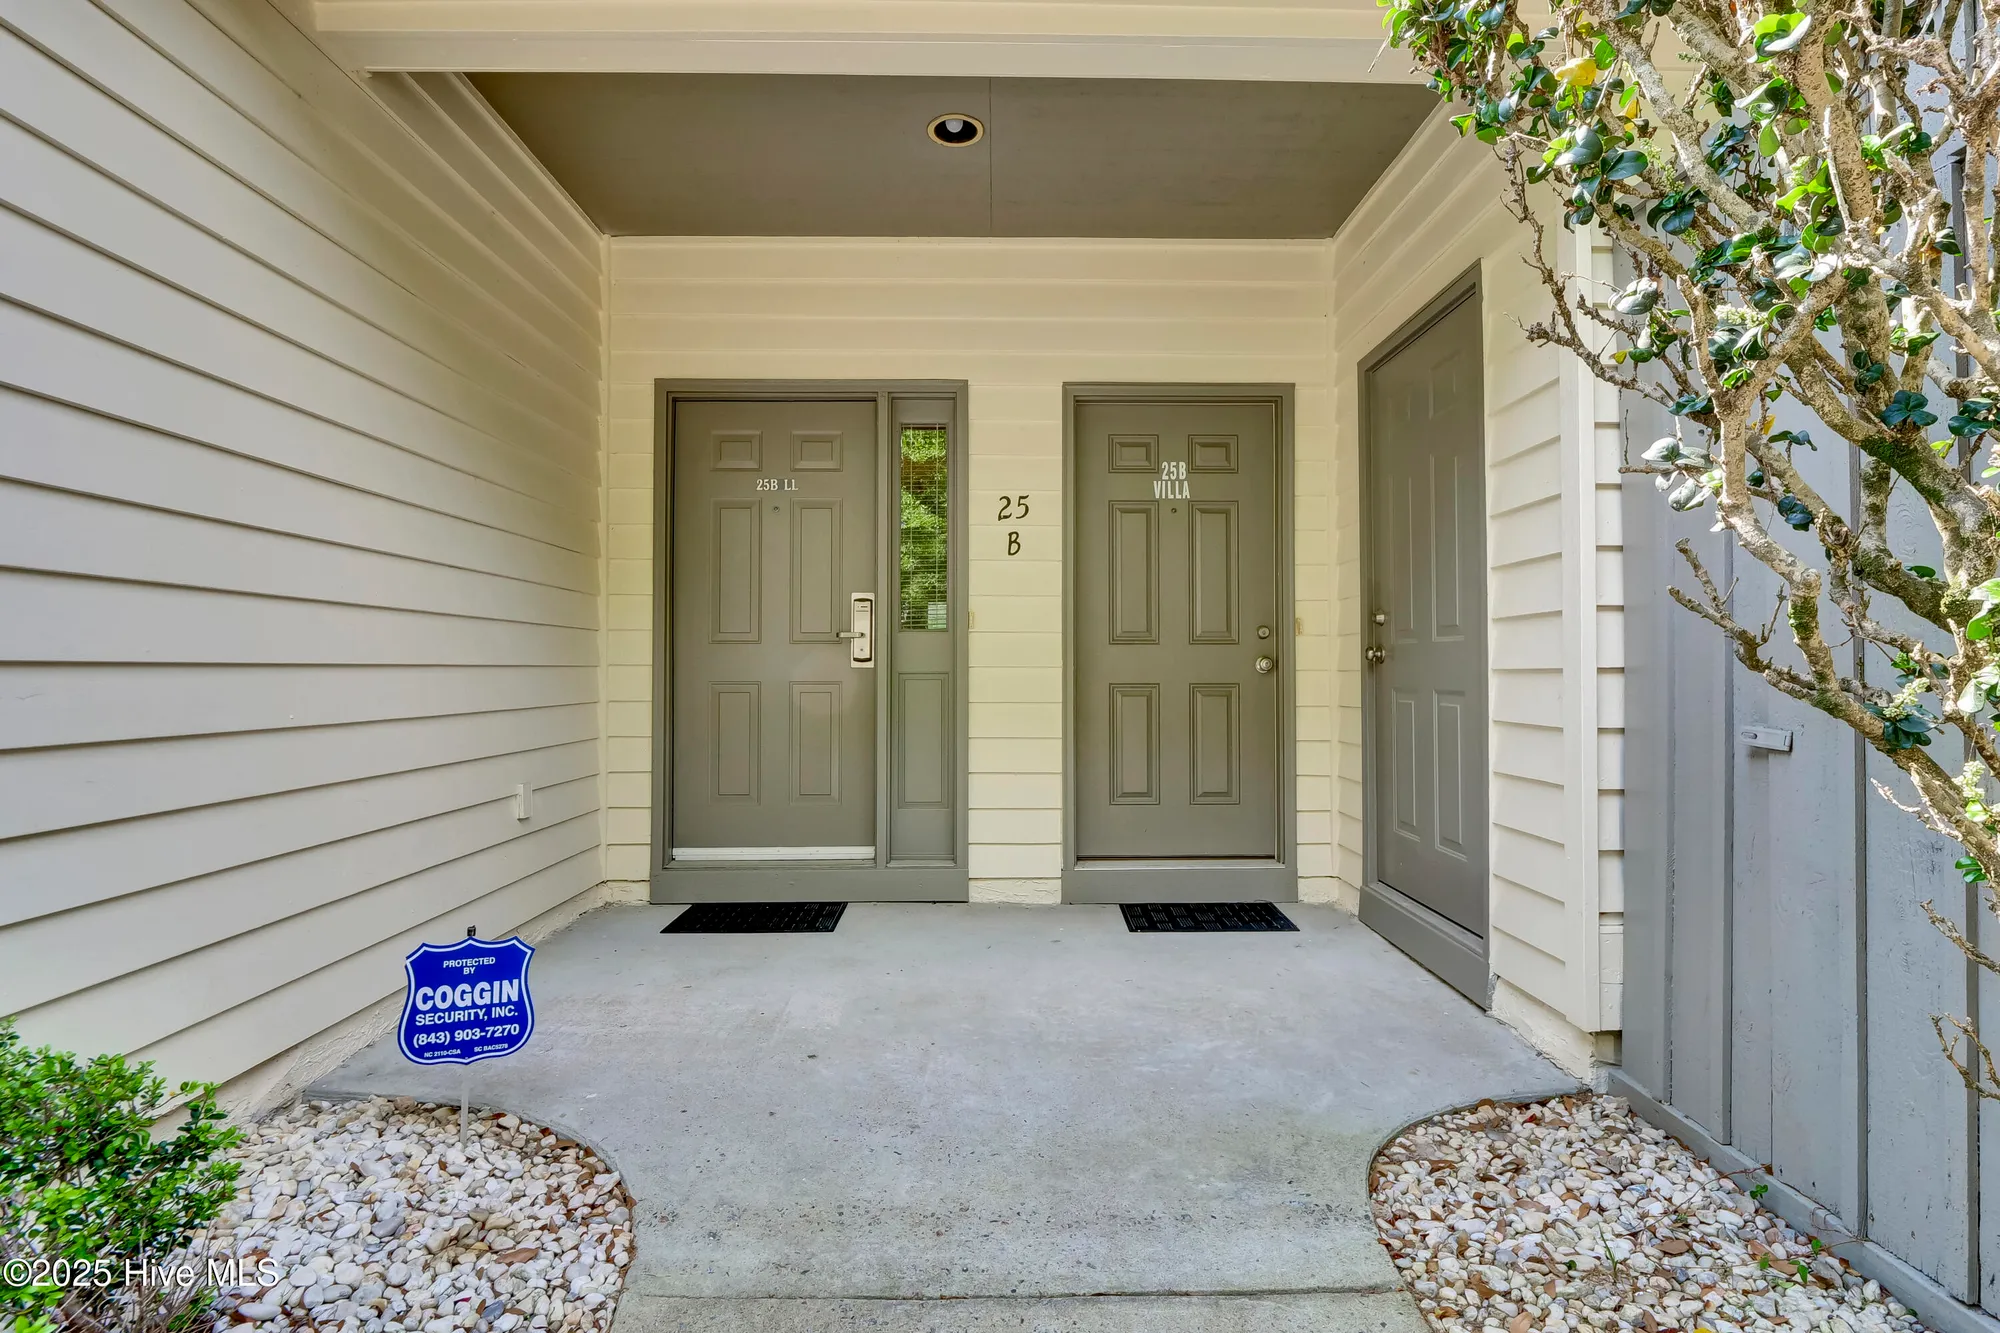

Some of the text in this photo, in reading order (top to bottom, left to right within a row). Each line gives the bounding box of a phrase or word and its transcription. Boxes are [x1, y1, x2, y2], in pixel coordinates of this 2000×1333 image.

[1161, 461, 1187, 481] 25B
[756, 479, 799, 491] 25B LL
[1153, 481, 1190, 500] VILLA
[997, 494, 1030, 522] 25
[1007, 531, 1021, 556] B
[443, 957, 495, 968] PROTECTED
[415, 979, 519, 1011] COGGIN
[416, 1006, 518, 1026] SECURITY, INC.
[413, 1024, 519, 1048] (843) 903-7270
